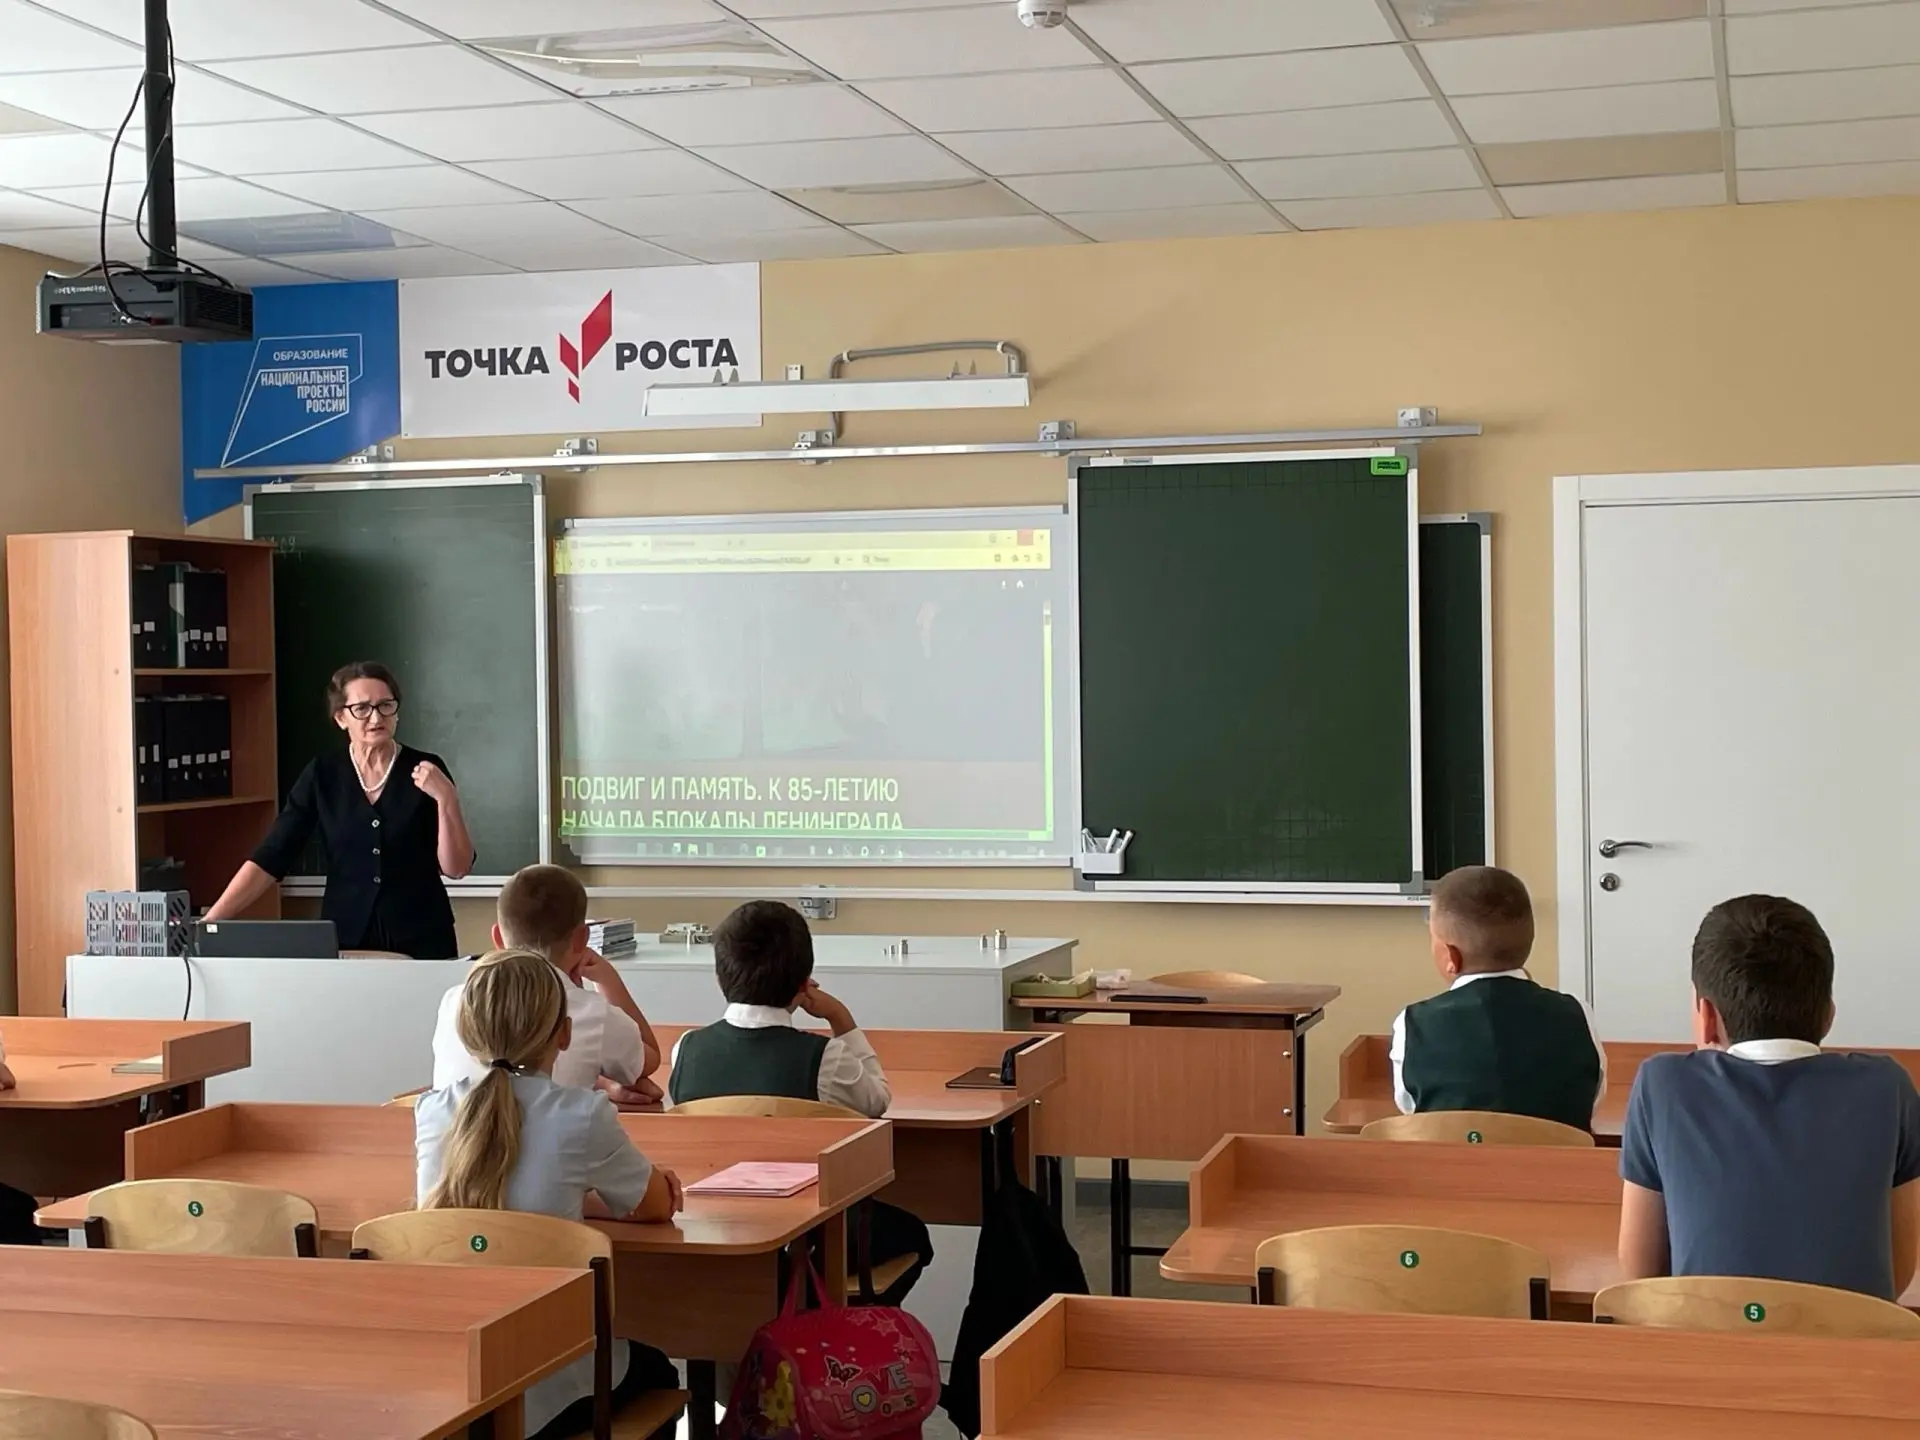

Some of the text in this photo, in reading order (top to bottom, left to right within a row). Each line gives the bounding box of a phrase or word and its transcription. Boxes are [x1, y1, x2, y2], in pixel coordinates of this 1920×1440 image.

[273, 348, 349, 362] ОБРАЗОВАНИЕ
[425, 338, 739, 379] ТОЧКА РОСТА
[261, 369, 346, 387] НАЦИОНАЛЬНЫЕ
[297, 384, 346, 400] ПРОЕКТЫ
[306, 398, 346, 413] РОССИИ
[561, 776, 899, 804] ПОДВИГ И ПАМЯТЬ. К 85-ЛЕТИЮ
[192, 1203, 199, 1215] 5
[475, 1238, 482, 1250] 5
[1405, 1253, 1413, 1266] 6
[1750, 1305, 1759, 1319] 5
[831, 1361, 914, 1420] LOVE
